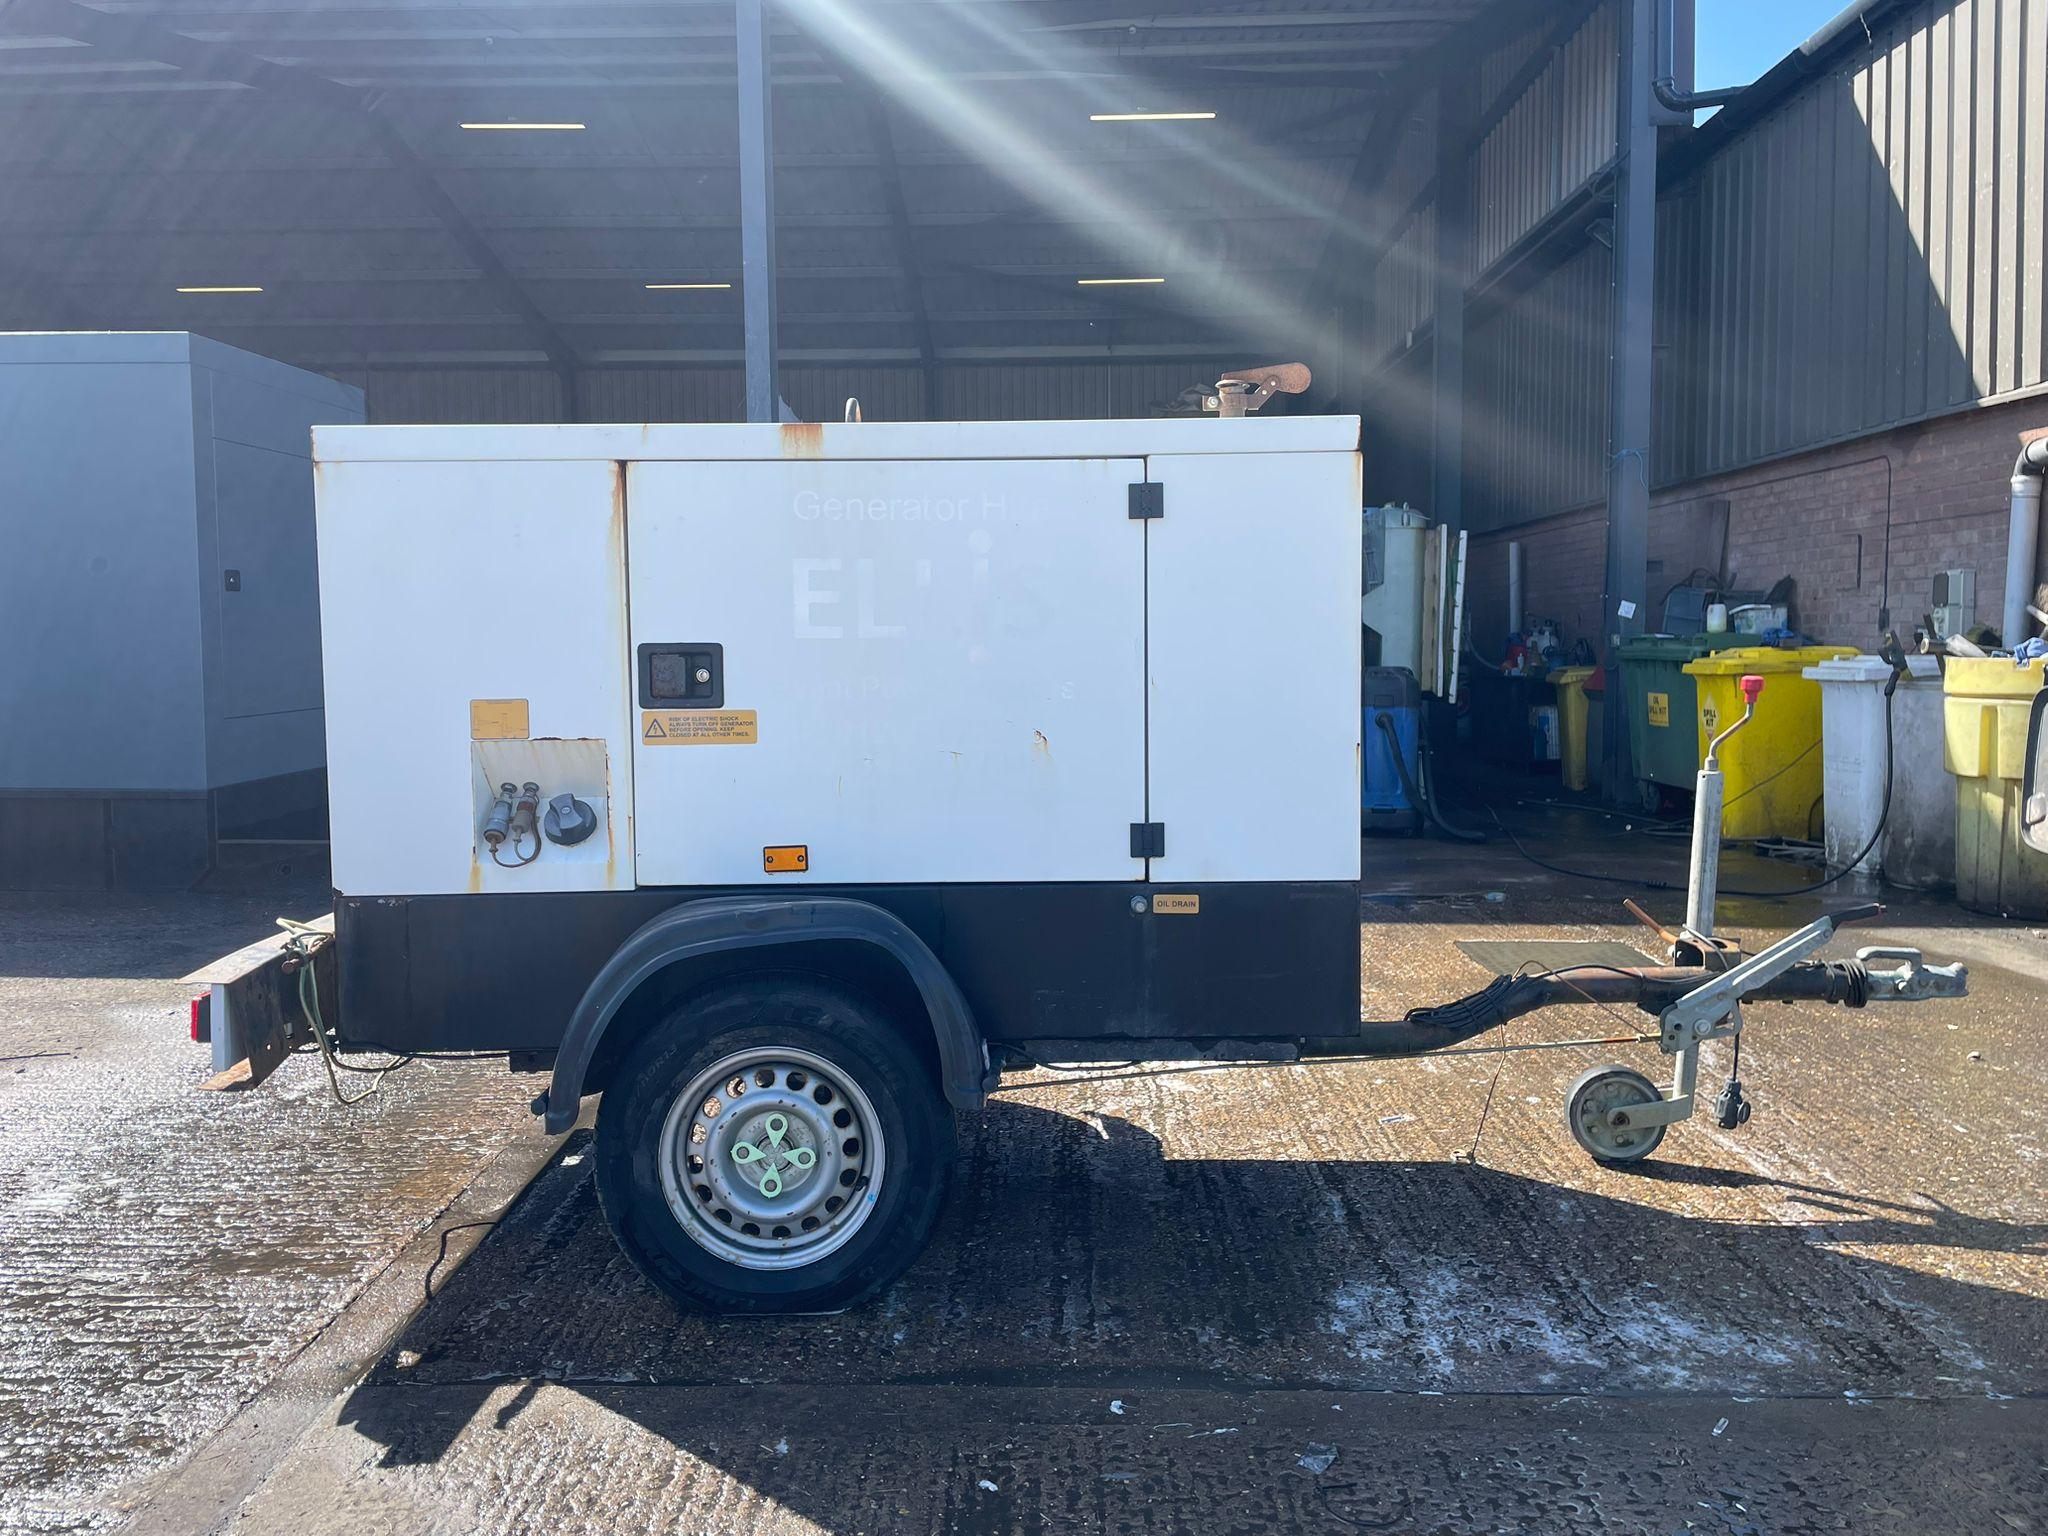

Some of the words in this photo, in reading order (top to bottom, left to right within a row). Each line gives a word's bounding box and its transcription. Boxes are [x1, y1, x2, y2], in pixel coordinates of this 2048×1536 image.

[793, 490, 969, 521] Generator
[1703, 709, 1716, 718] SPILL
[1706, 719, 1714, 727] KIT
